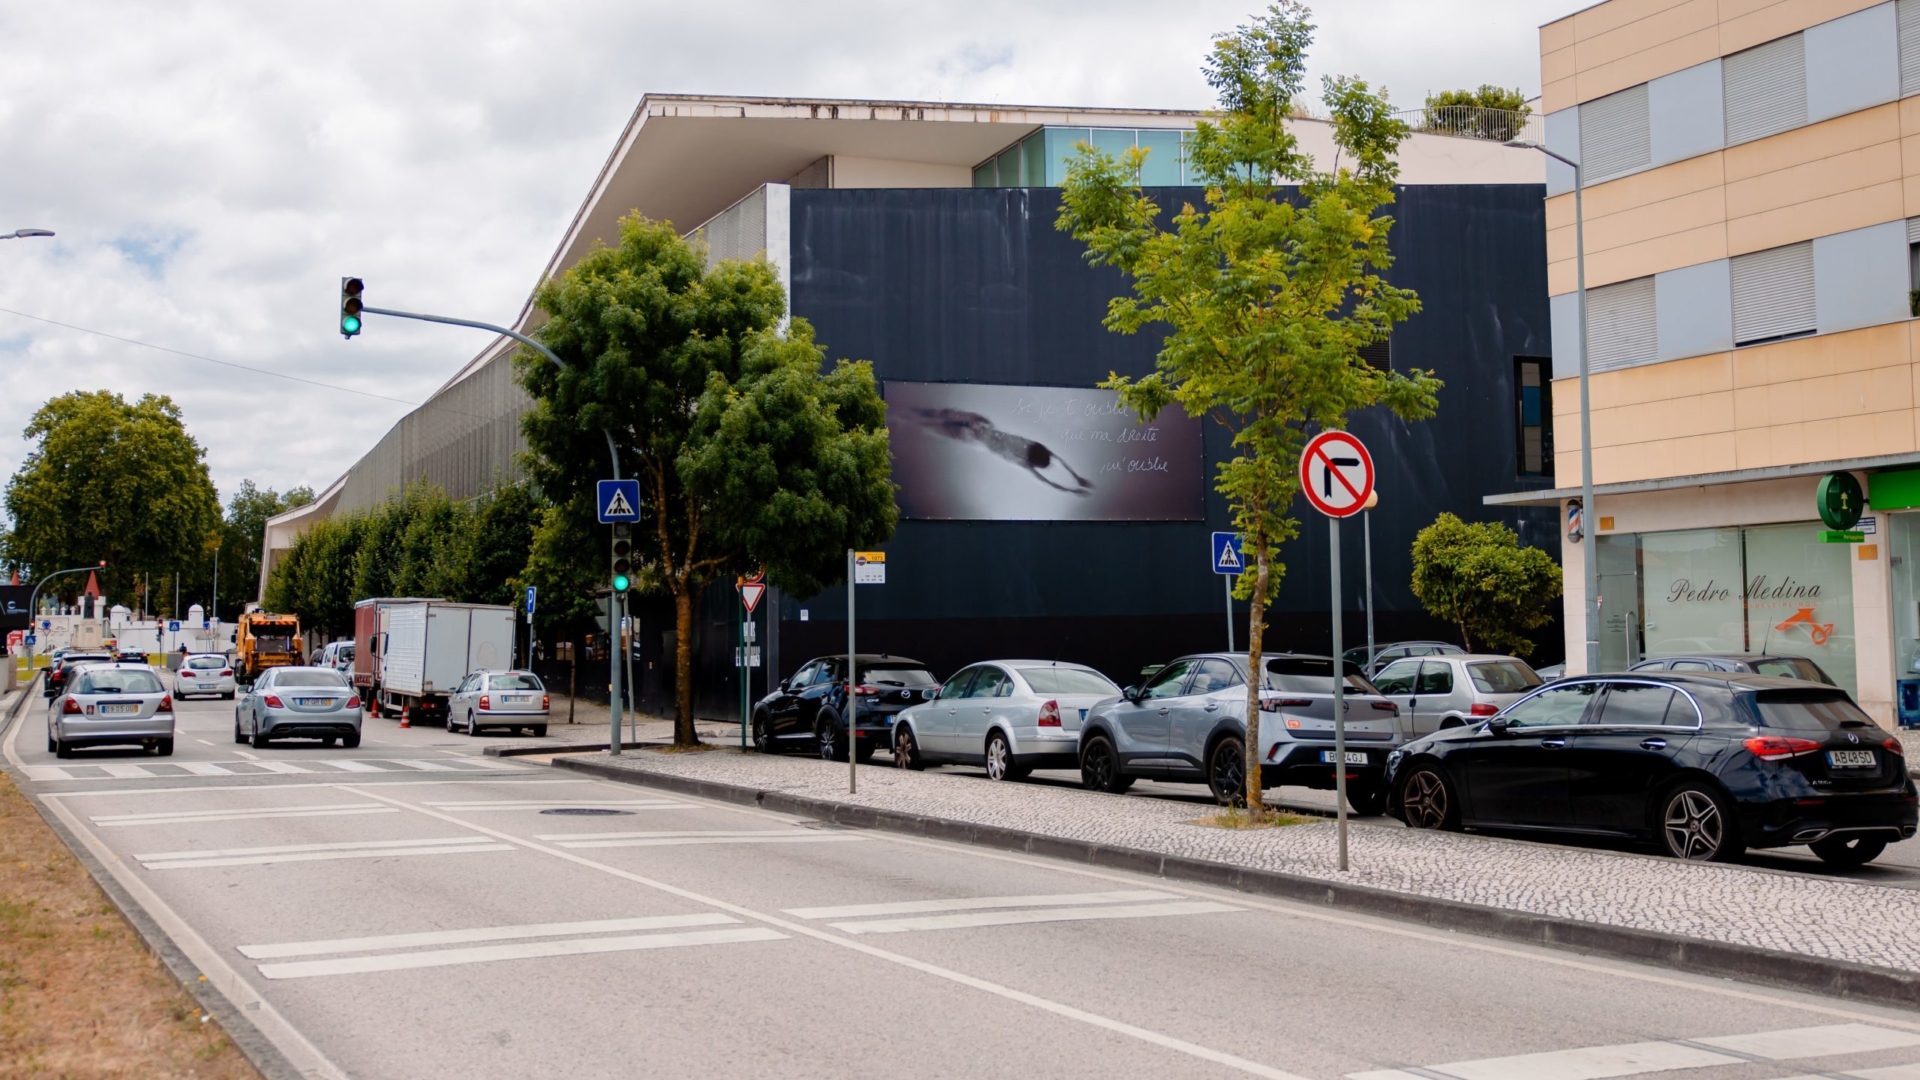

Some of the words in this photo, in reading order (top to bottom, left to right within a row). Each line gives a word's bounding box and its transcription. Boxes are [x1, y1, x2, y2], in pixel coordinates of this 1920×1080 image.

[1060, 429, 1085, 449] que
[1090, 430, 1112, 442] ma
[1667, 578, 1729, 602] Pedro
[1738, 574, 1821, 600] Medina
[528, 589, 534, 611] P
